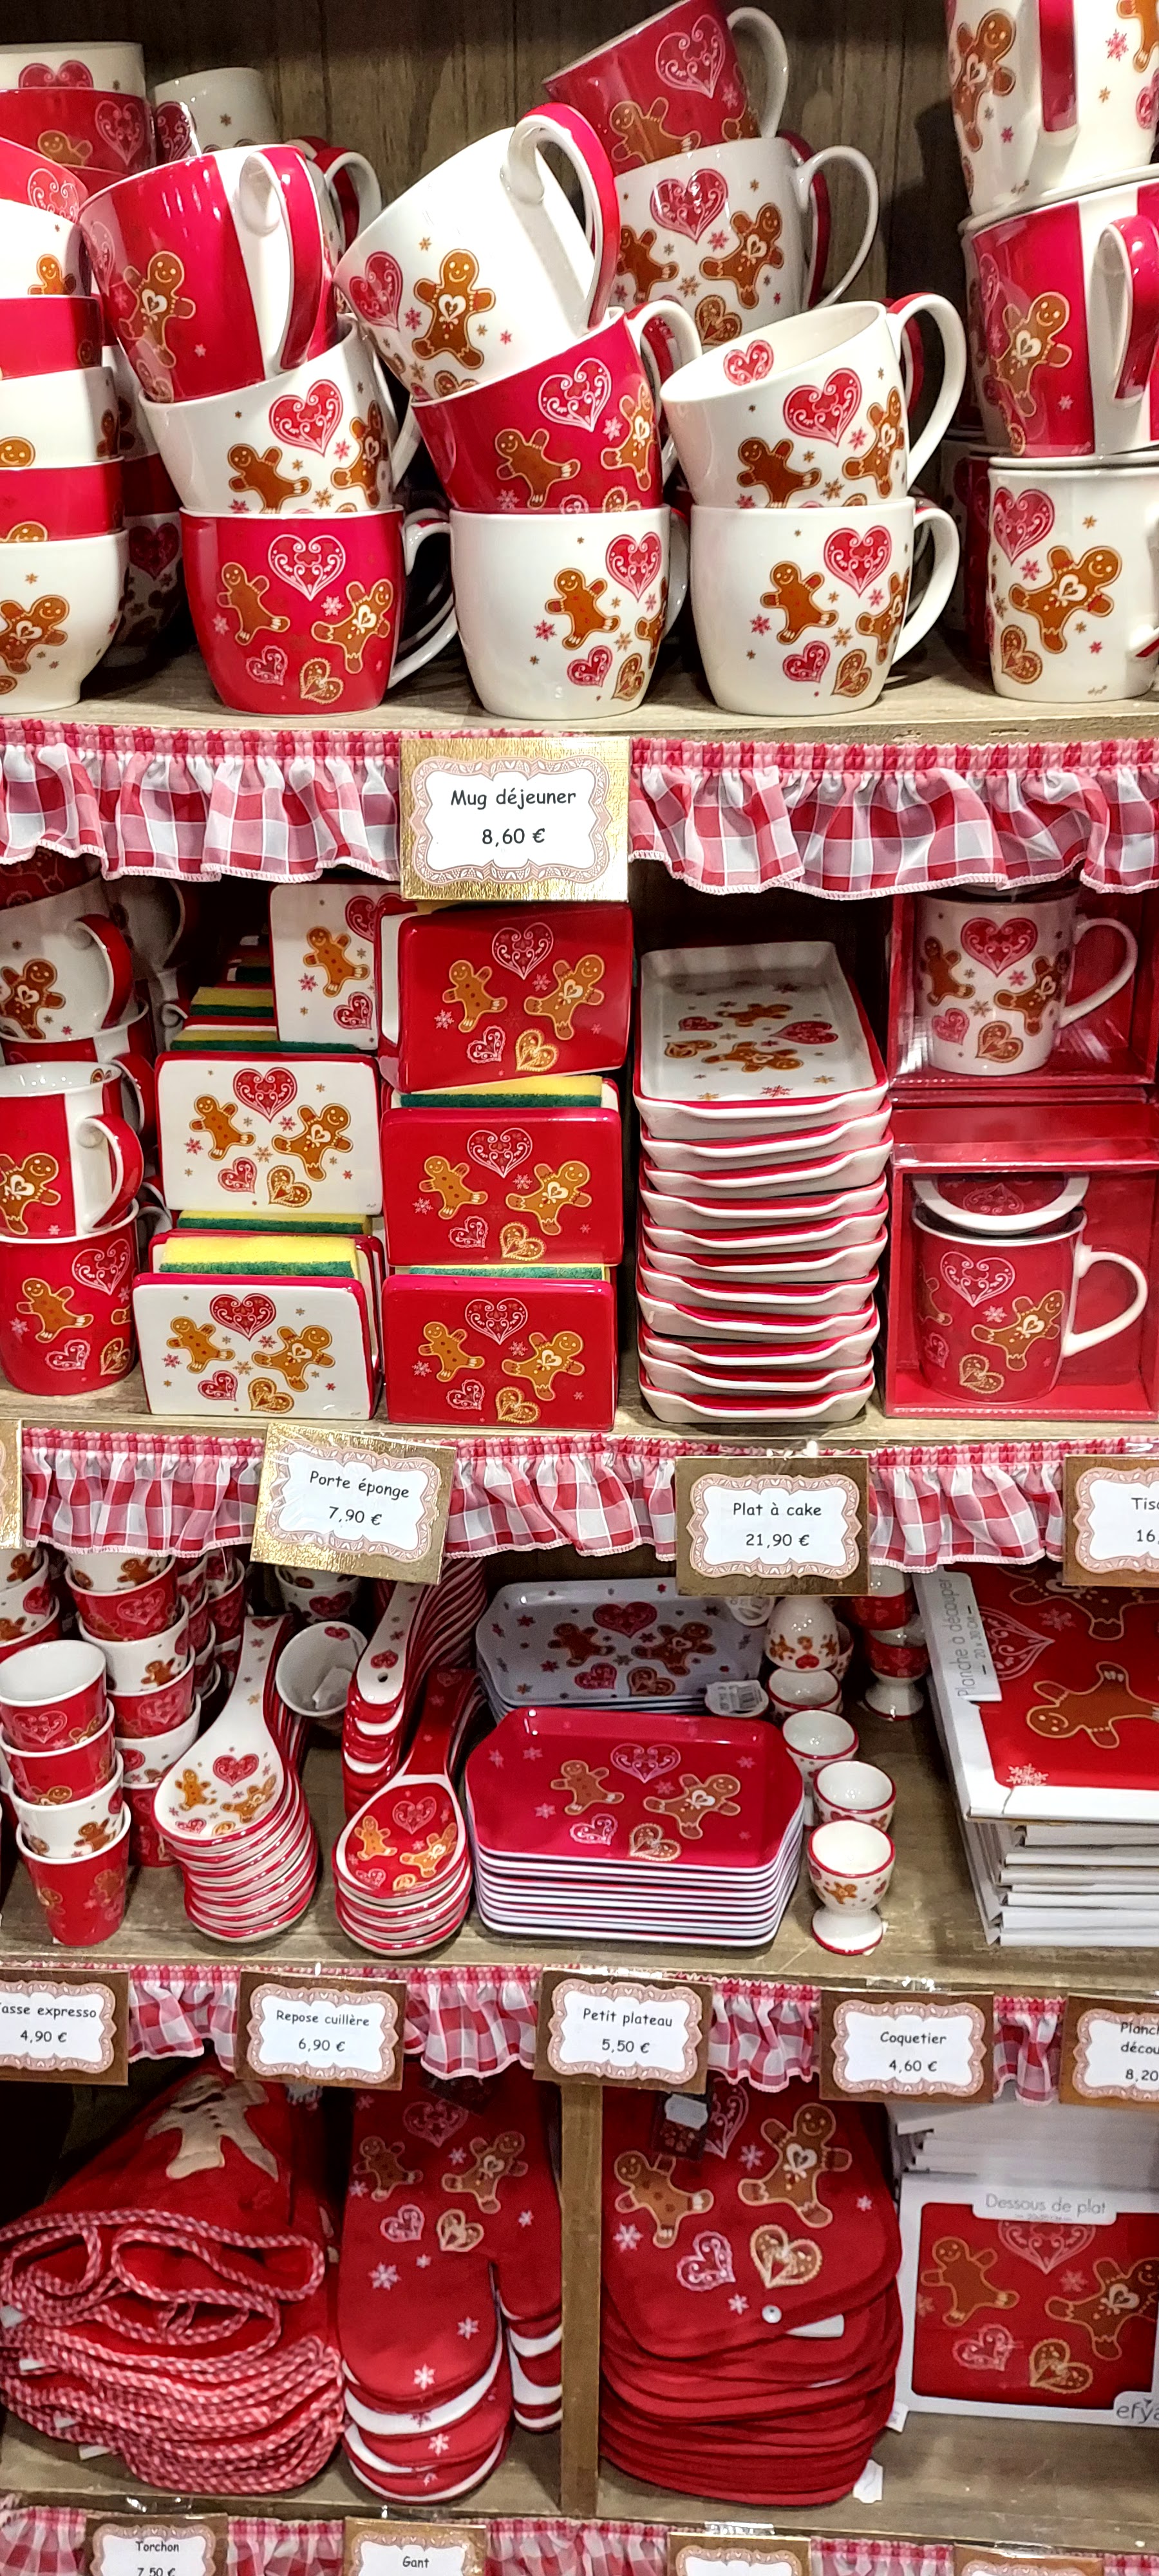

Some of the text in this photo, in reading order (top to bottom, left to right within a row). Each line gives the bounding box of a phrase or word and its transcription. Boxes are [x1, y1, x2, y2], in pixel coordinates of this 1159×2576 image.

[450, 787, 576, 810] Mug déjeuner
[482, 828, 545, 848] 8,60 €
[310, 1470, 410, 1501] Porte éponge
[329, 1506, 382, 1526] 7,90 €
[733, 1502, 822, 1516] Plat à cake
[746, 1533, 810, 1549] 21,90 €
[938, 1578, 962, 1632] découper
[949, 1648, 975, 1698] Planche
[0, 2002, 97, 2020] asse expresso
[276, 2009, 370, 2026] Repose cuillère
[583, 2007, 673, 2027] Petit plateau
[20, 2029, 68, 2043] 4,90 €
[880, 2031, 947, 2047] Coquetier
[298, 2038, 346, 2052] 6,90 €
[601, 2038, 650, 2054] 5,50 €
[889, 2059, 938, 2074] 4,60 €
[1125, 2069, 1159, 2082] 8,20
[986, 2193, 1047, 2211] Dessous
[1052, 2197, 1072, 2213] de
[1077, 2199, 1106, 2218] plat
[135, 2541, 180, 2552] Torchon
[402, 2555, 429, 2568] Gant
